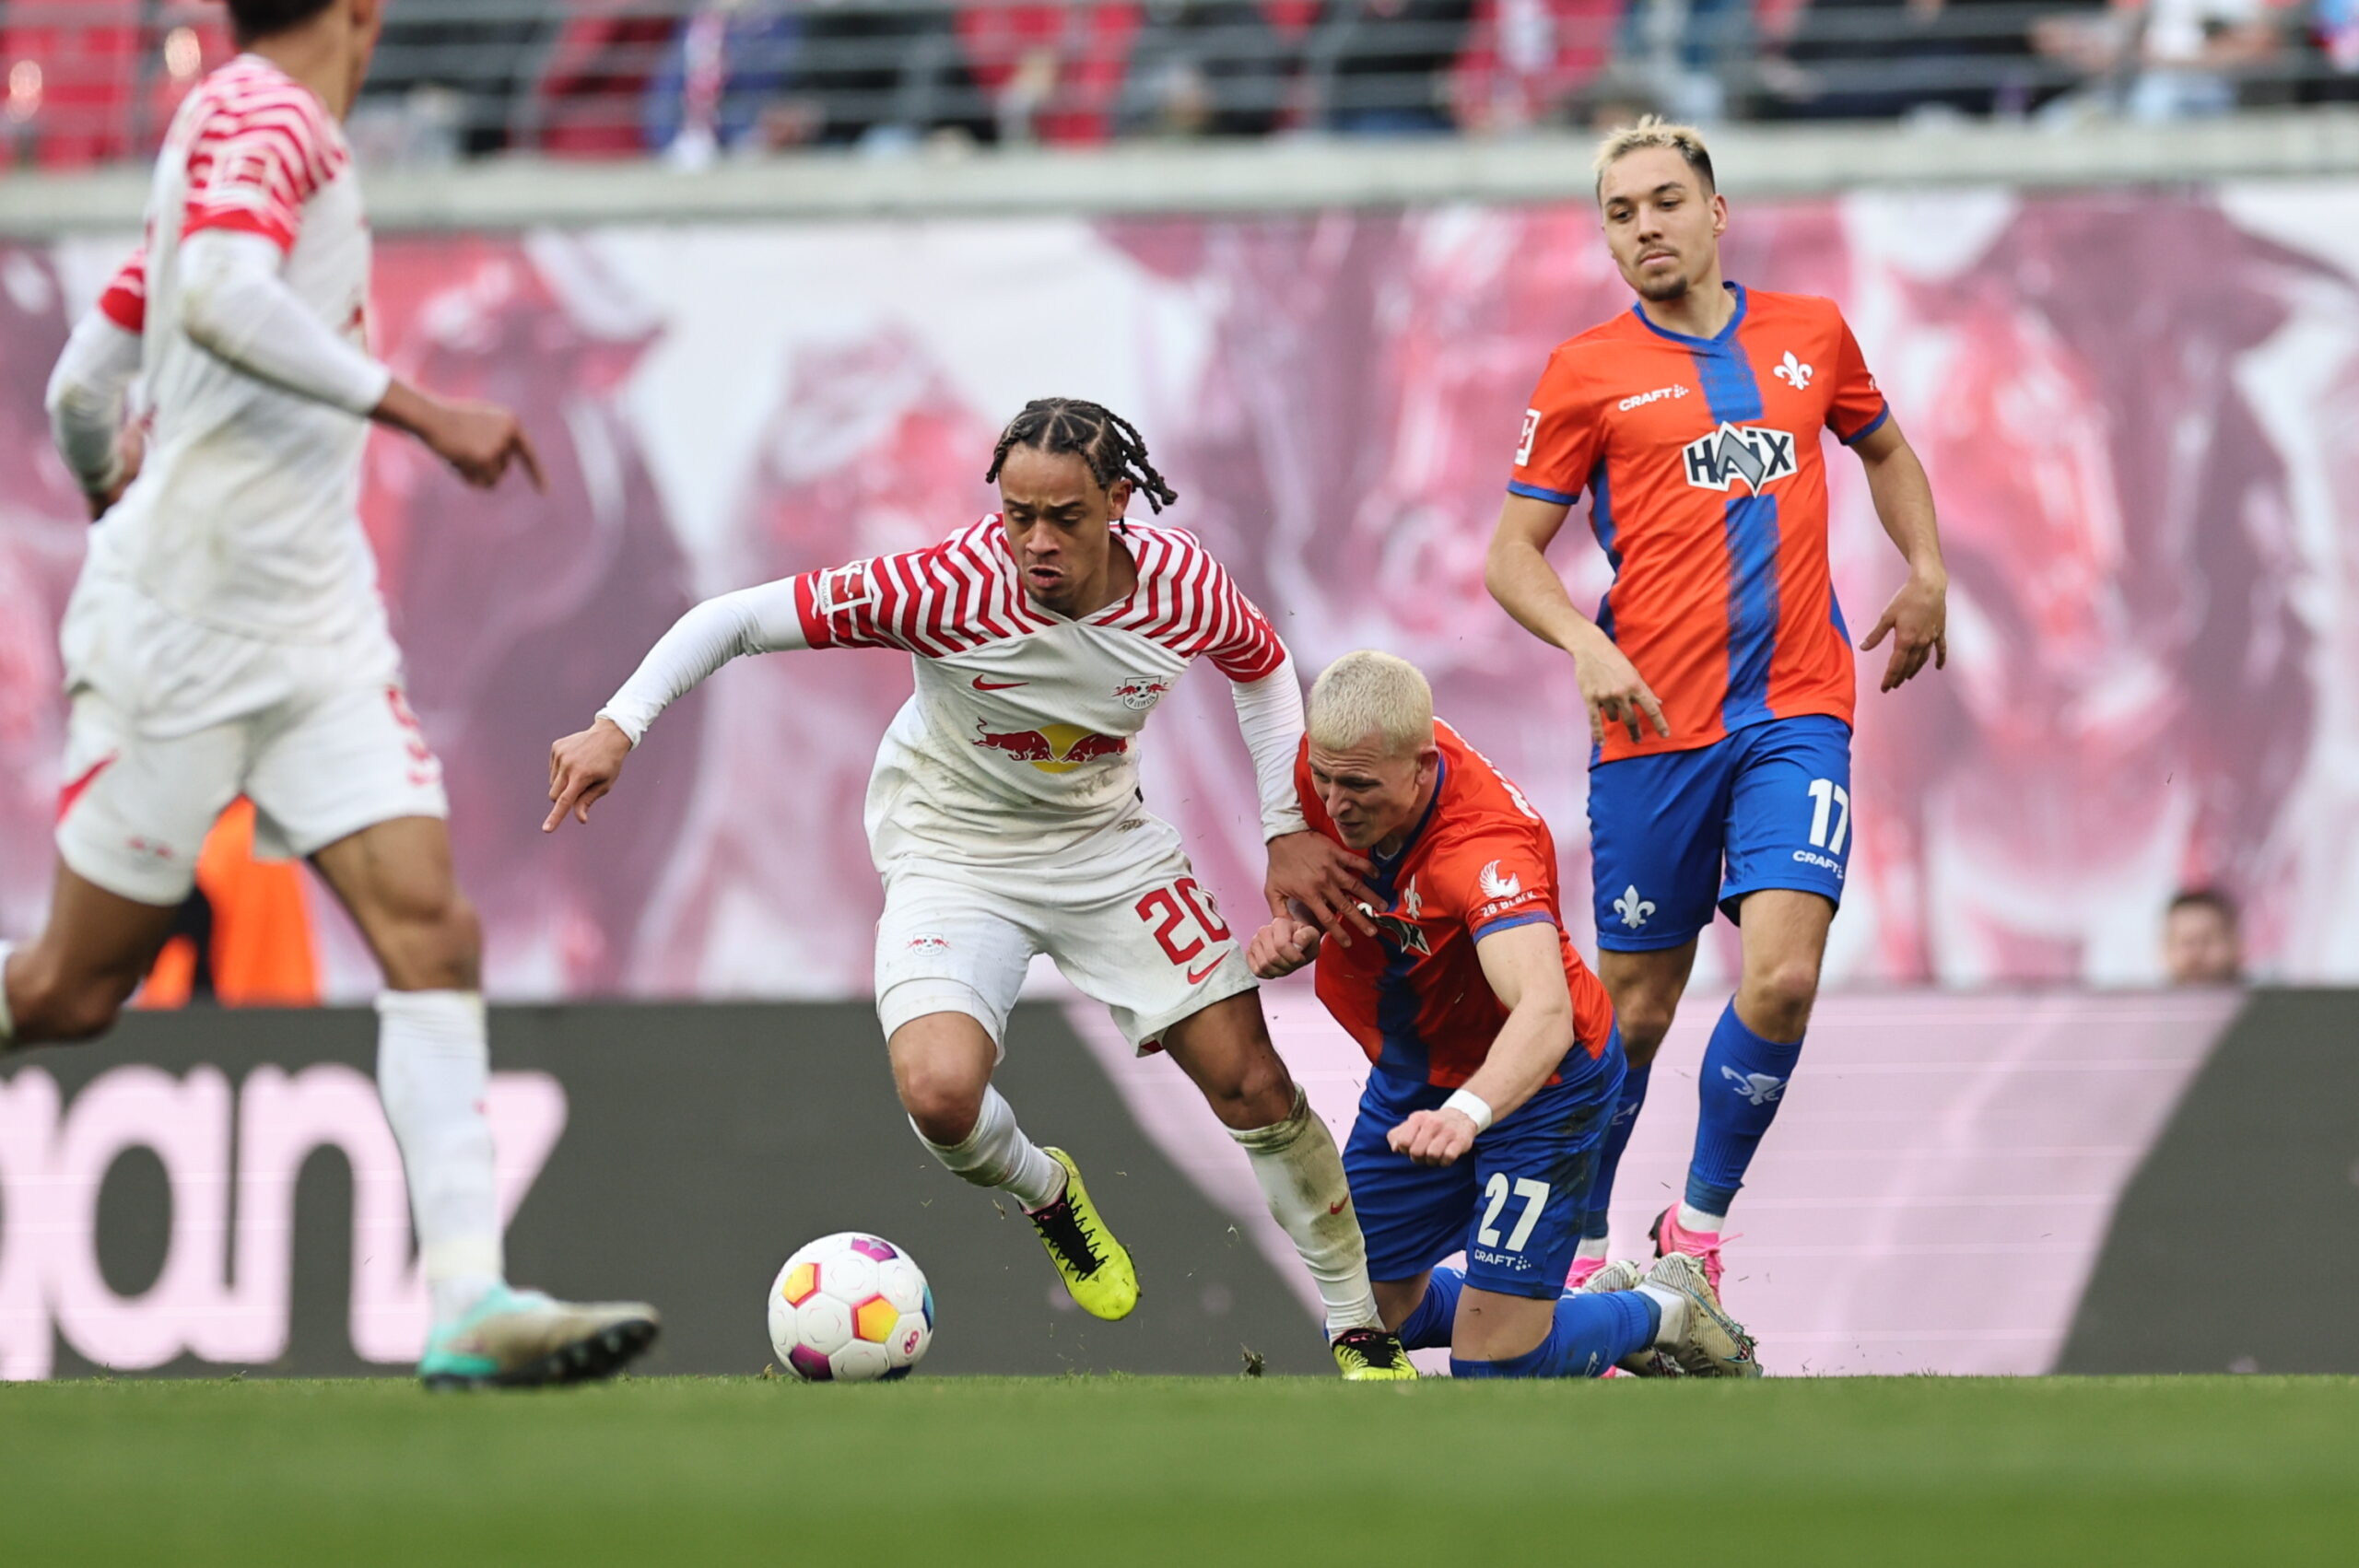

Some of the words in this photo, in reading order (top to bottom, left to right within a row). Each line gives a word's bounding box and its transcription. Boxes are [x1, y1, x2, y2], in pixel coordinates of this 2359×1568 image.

[1618, 388, 1672, 411] CRAFT
[1808, 778, 1849, 855] 17
[1792, 849, 1839, 873] CRAFT
[1134, 877, 1231, 965] 20
[1480, 903, 1497, 918] 28
[1477, 1172, 1550, 1252] 27
[1474, 1248, 1516, 1268] CRAFT
